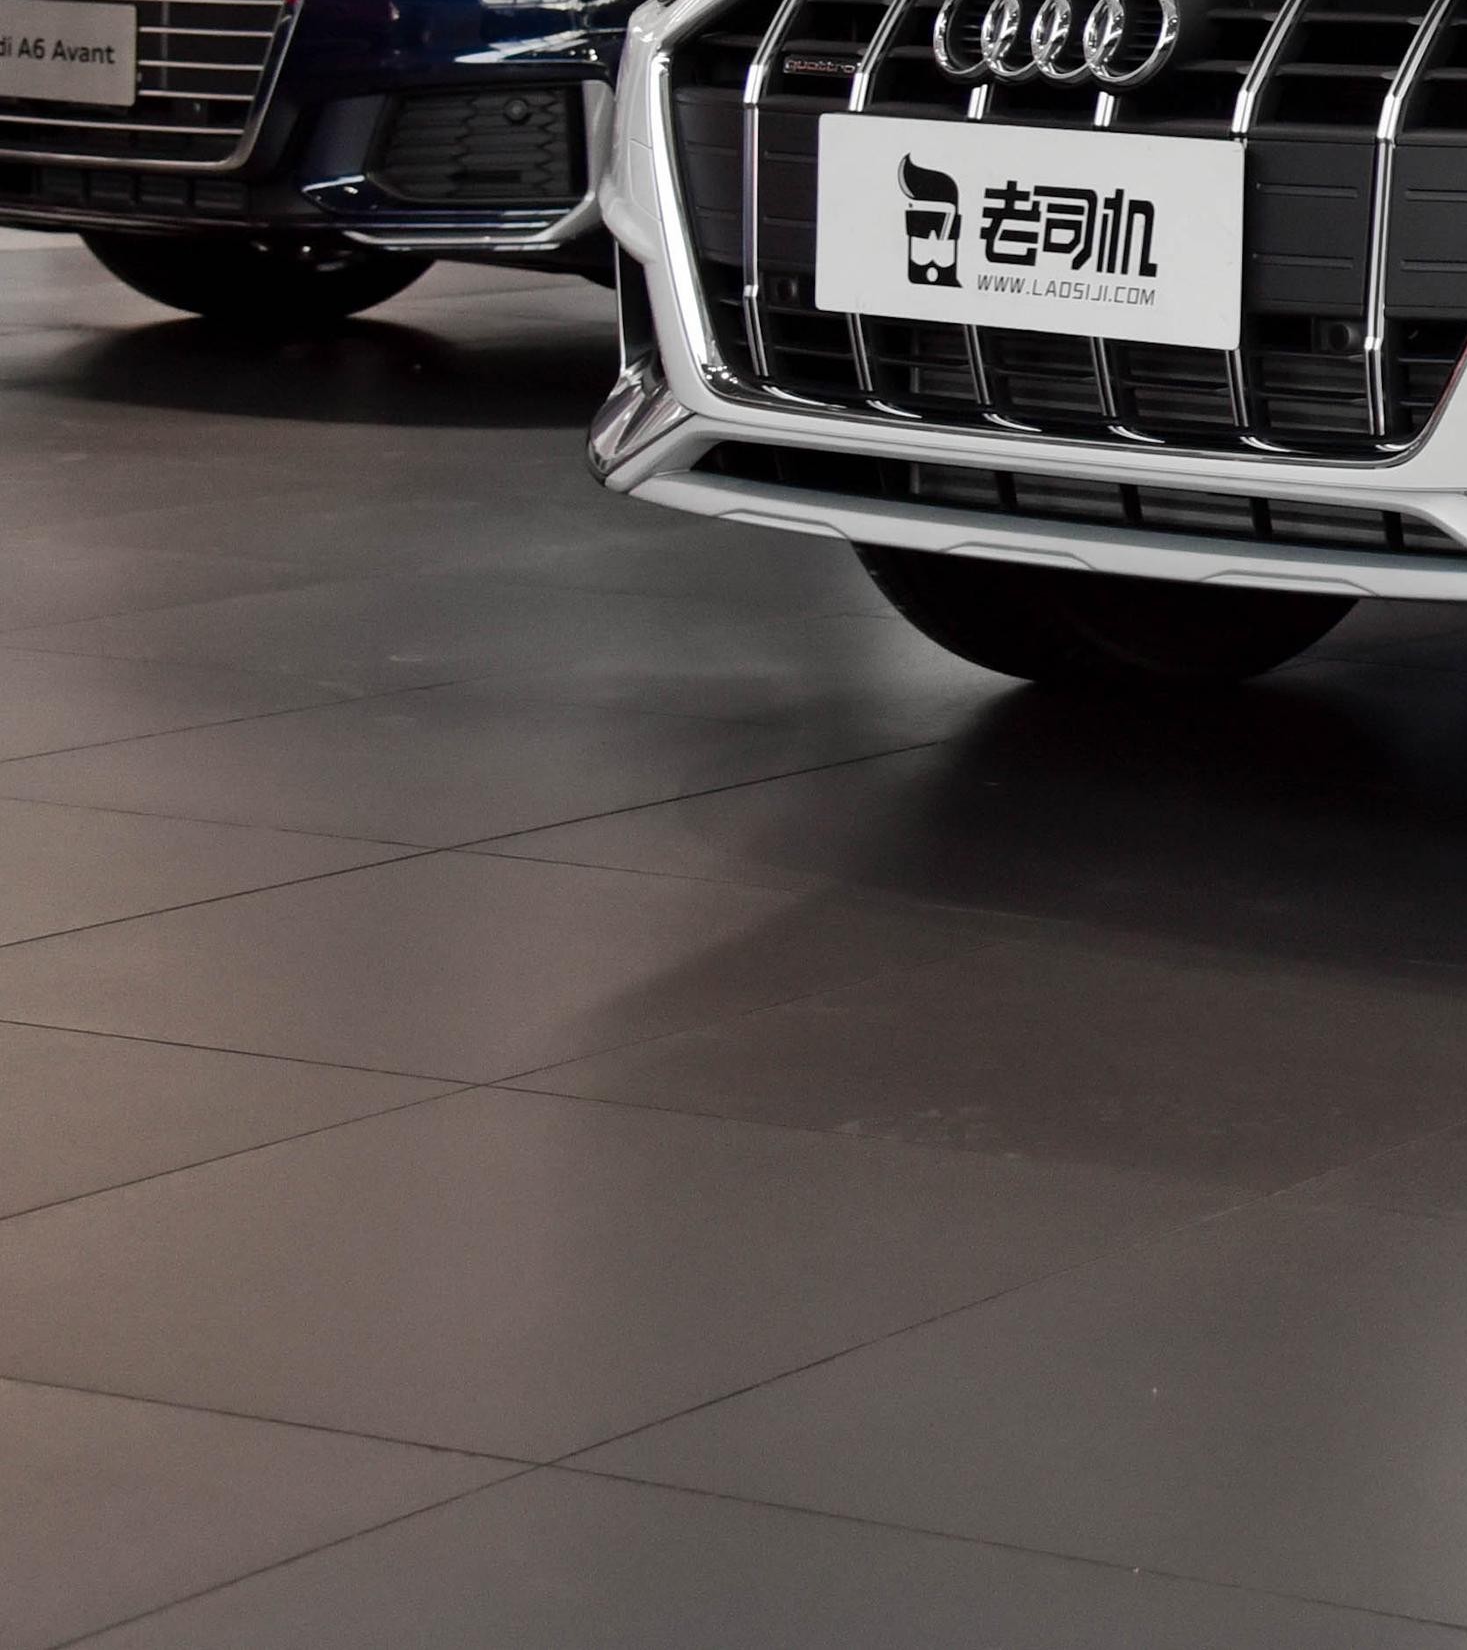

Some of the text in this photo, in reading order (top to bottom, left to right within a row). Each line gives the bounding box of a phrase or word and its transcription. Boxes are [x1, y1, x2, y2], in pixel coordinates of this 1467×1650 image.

[18, 36, 46, 60] A6
[51, 38, 116, 64] Avant
[979, 179, 1158, 278] 老司机
[977, 273, 1157, 307] WWW.LAOSIJI.COM
